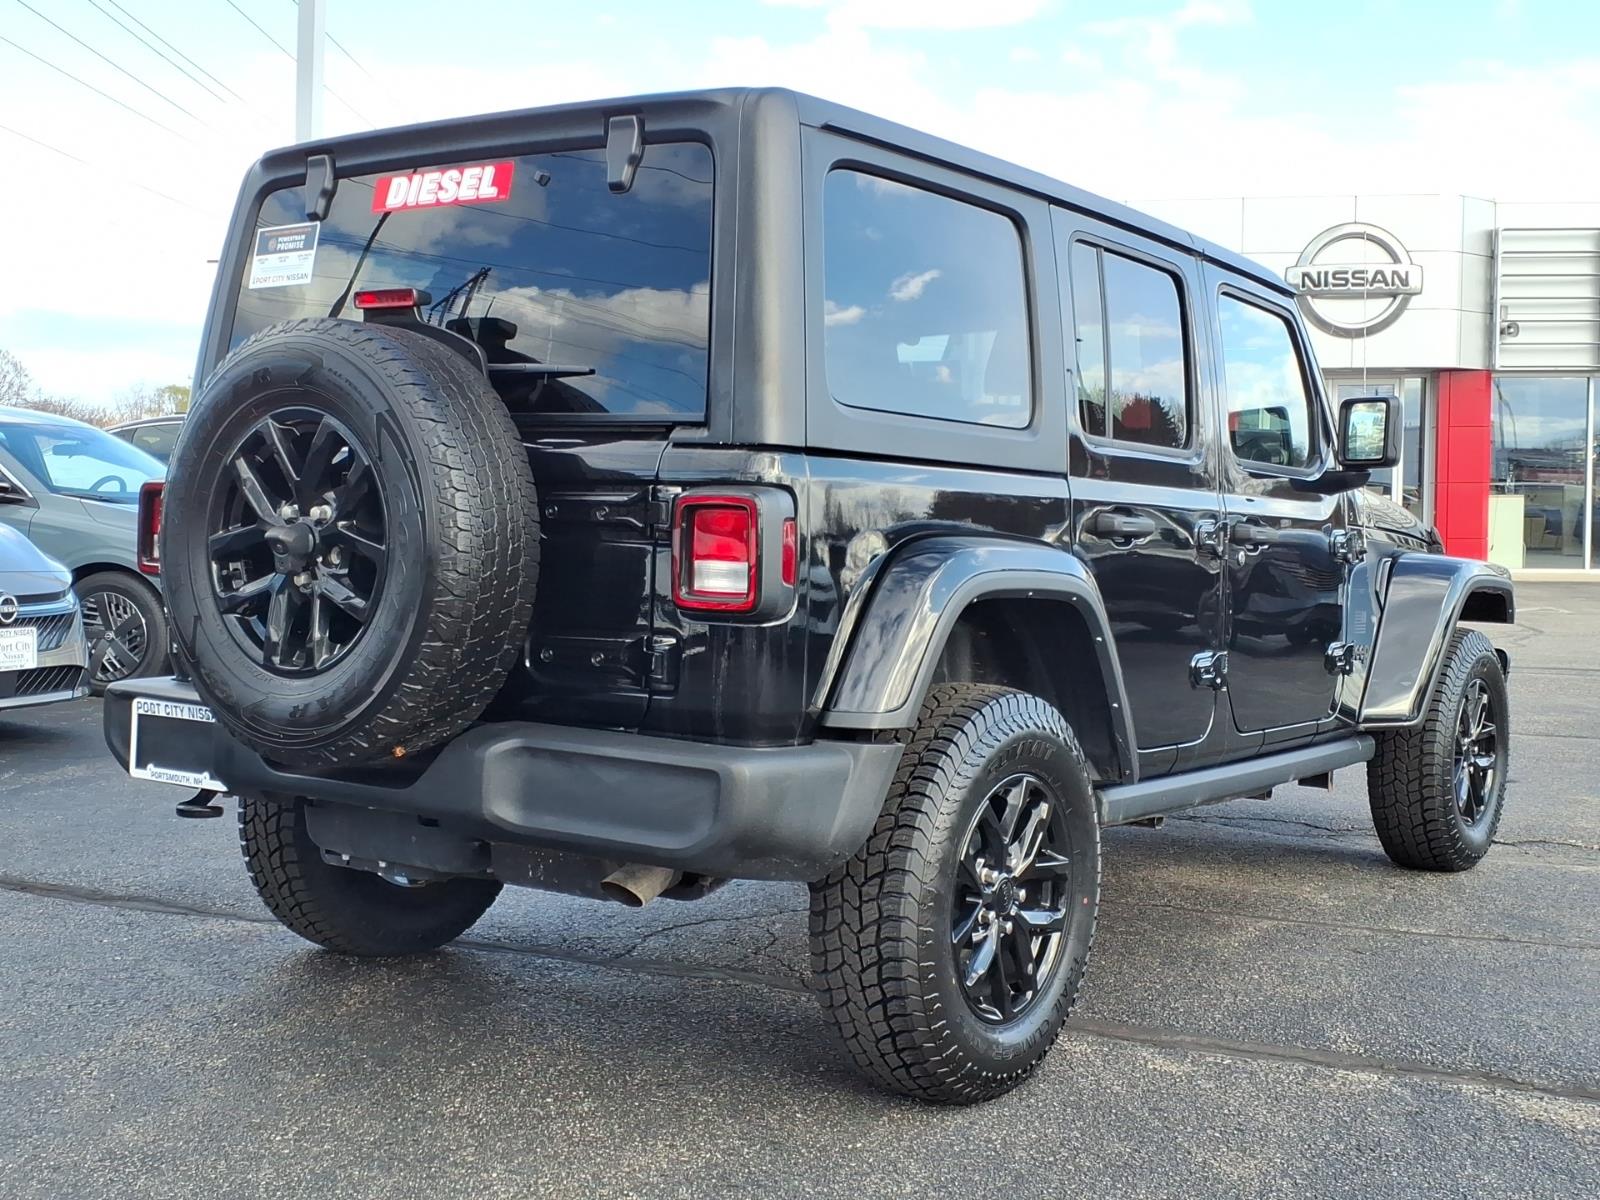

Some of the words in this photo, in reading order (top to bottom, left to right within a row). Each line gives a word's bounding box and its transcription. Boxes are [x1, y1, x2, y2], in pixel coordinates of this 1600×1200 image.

[385, 165, 498, 209] DIESEL
[276, 241, 305, 251] PROMISE
[286, 272, 309, 281] NISSAN
[1301, 269, 1410, 289] NISSAN
[164, 704, 185, 717] CITY
[188, 707, 213, 721] NISS
[193, 778, 203, 786] NH
